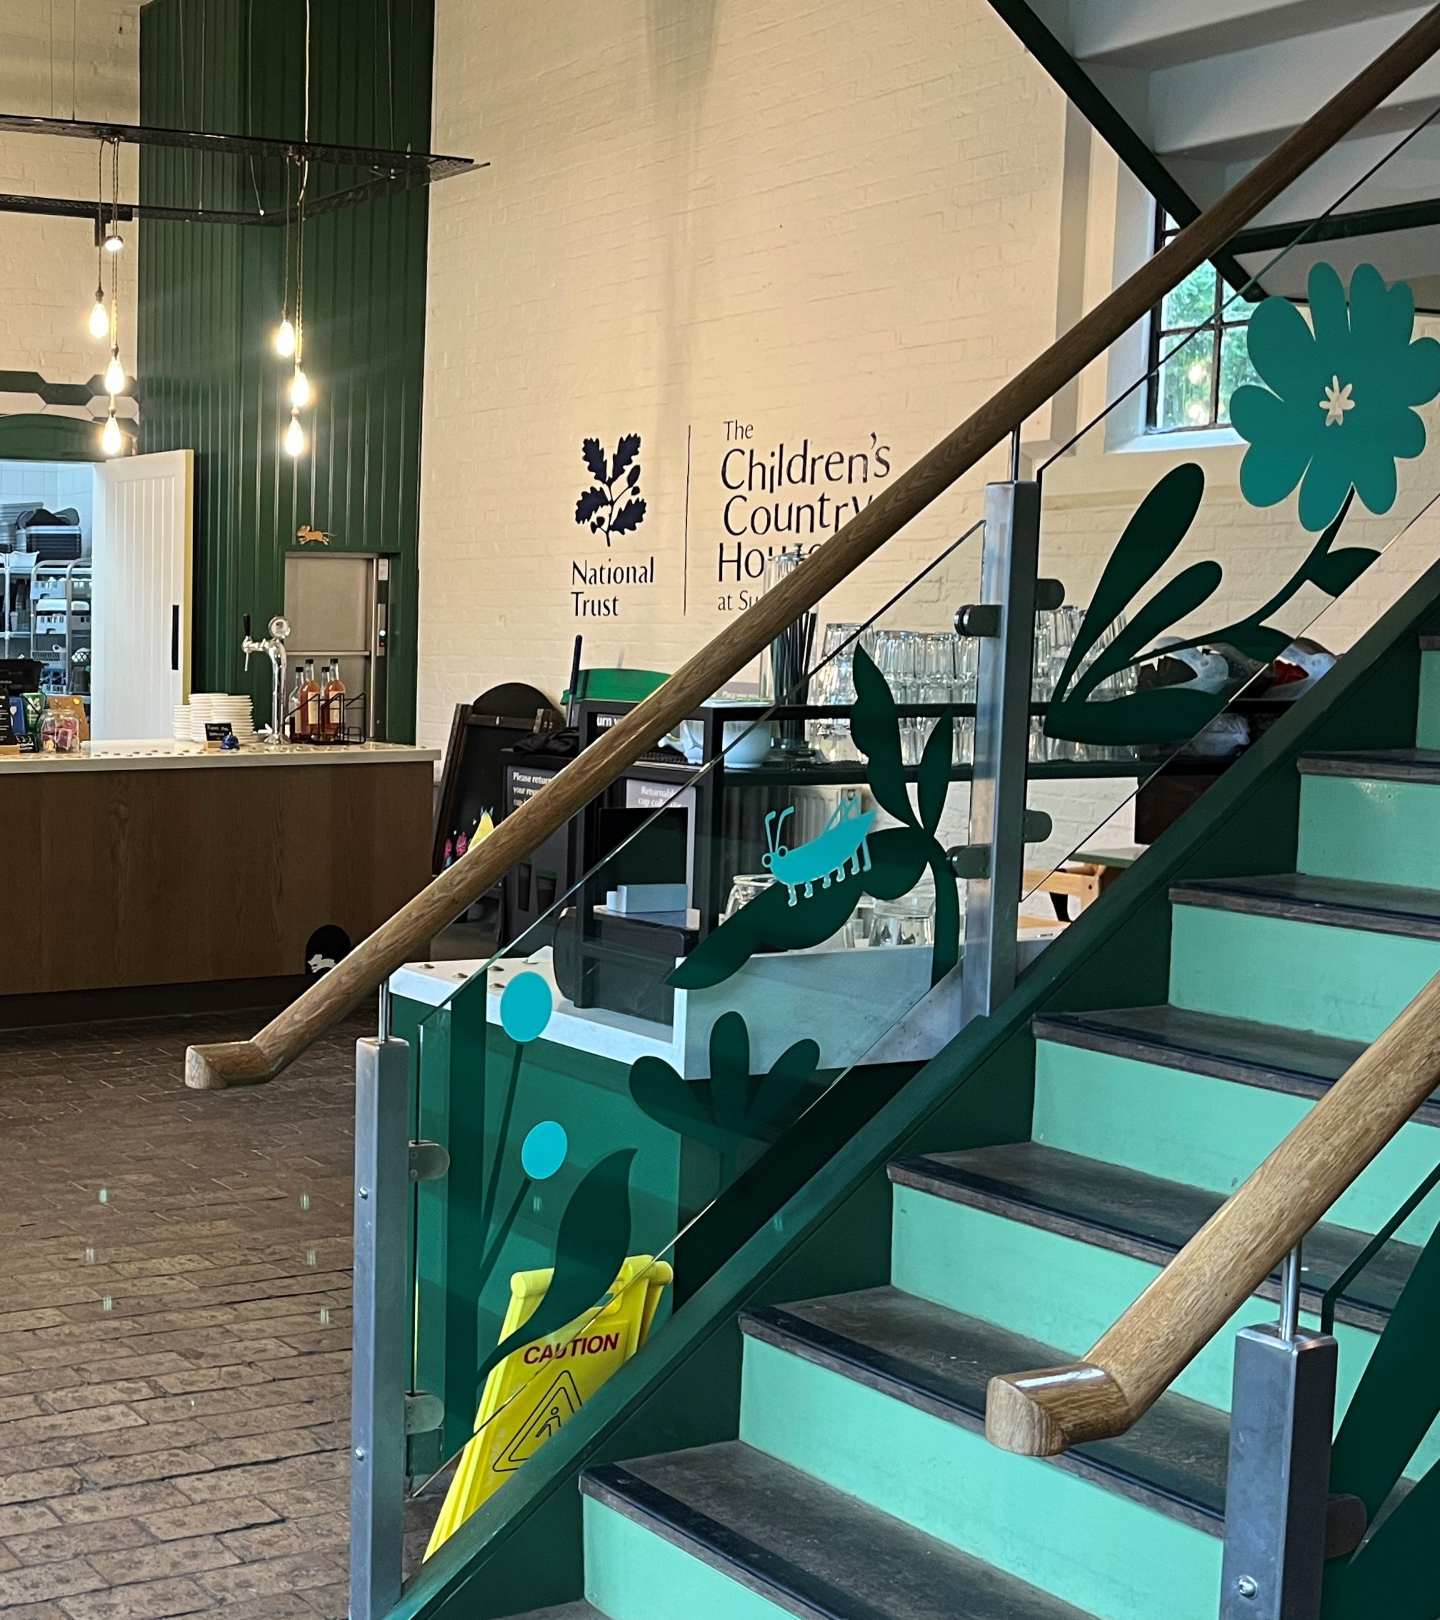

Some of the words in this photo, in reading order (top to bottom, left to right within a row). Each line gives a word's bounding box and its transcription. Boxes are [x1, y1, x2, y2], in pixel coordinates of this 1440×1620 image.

[724, 420, 754, 441] The
[572, 556, 655, 586] National
[571, 591, 619, 618] Trust
[717, 594, 732, 611] at
[597, 716, 612, 726] urn
[513, 772, 531, 783] Please
[638, 797, 650, 807] cup
[524, 1333, 620, 1365] CAUTION
